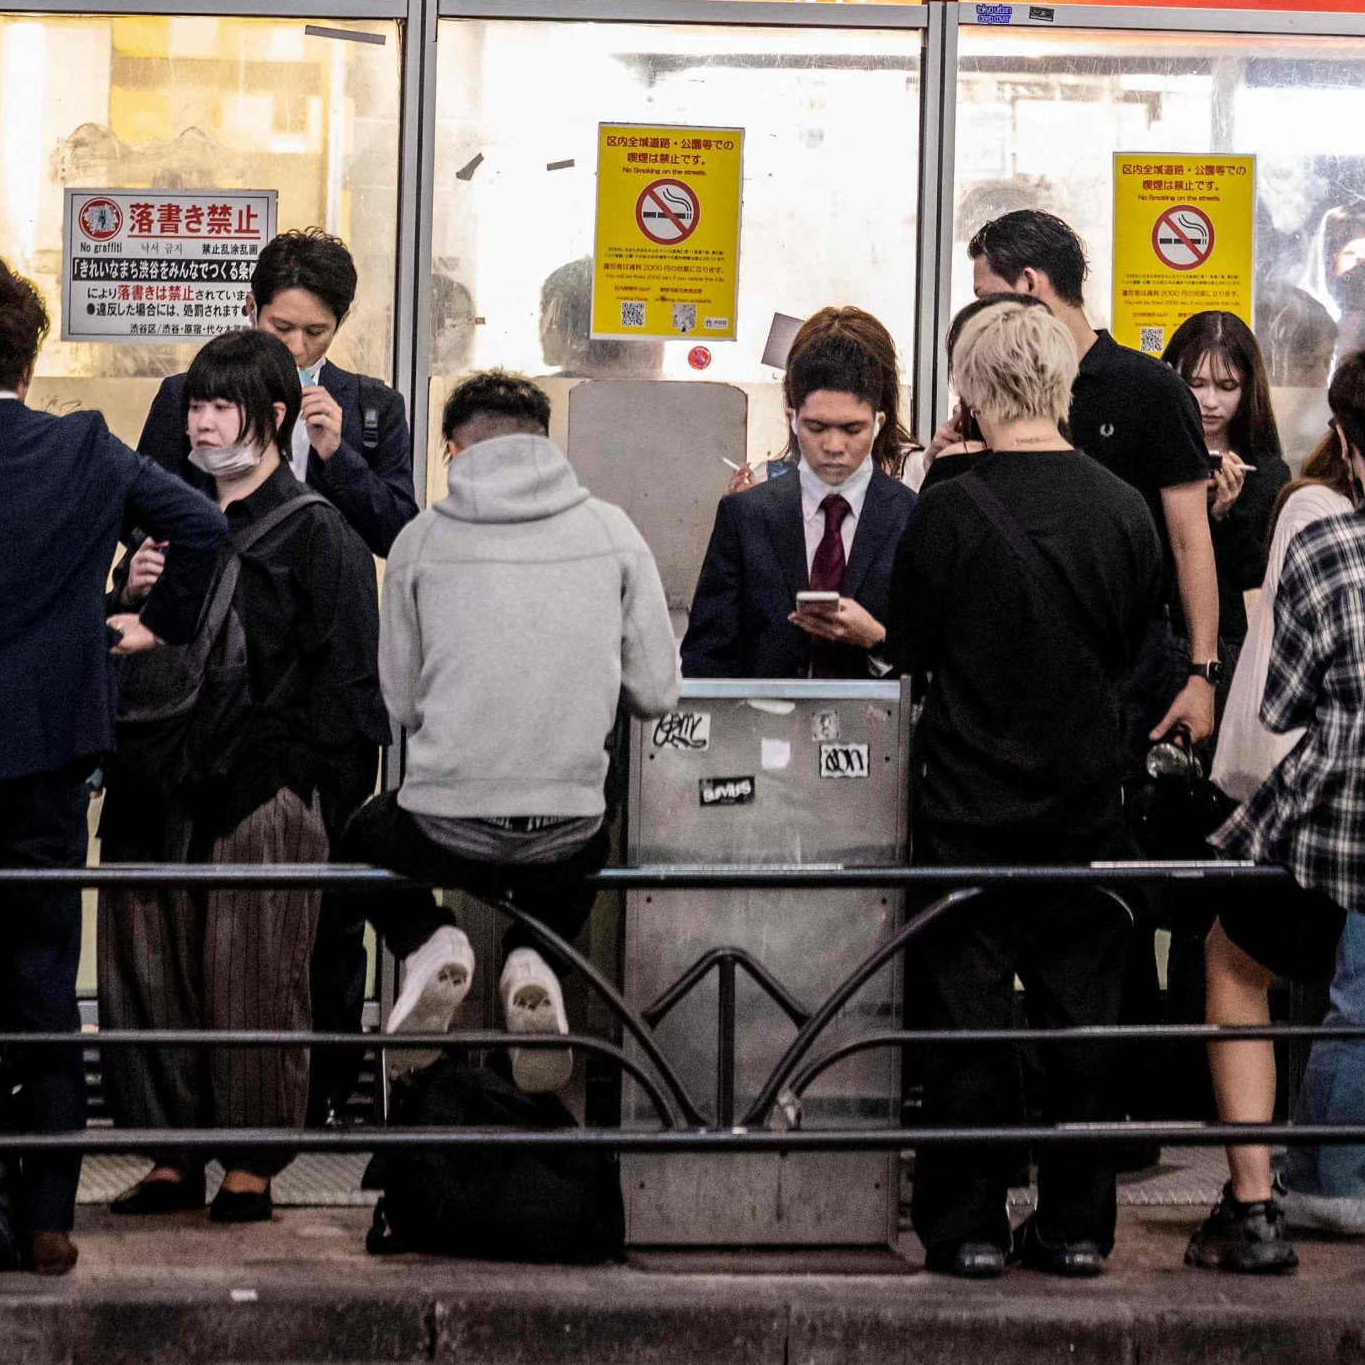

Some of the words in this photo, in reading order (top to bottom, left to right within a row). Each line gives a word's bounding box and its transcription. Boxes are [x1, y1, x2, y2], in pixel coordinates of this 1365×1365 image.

[129, 203, 260, 235] 落書き禁止
[80, 243, 91, 253] No
[94, 242, 123, 254] graffiti
[87, 284, 250, 301] により落書きは禁止されていま
